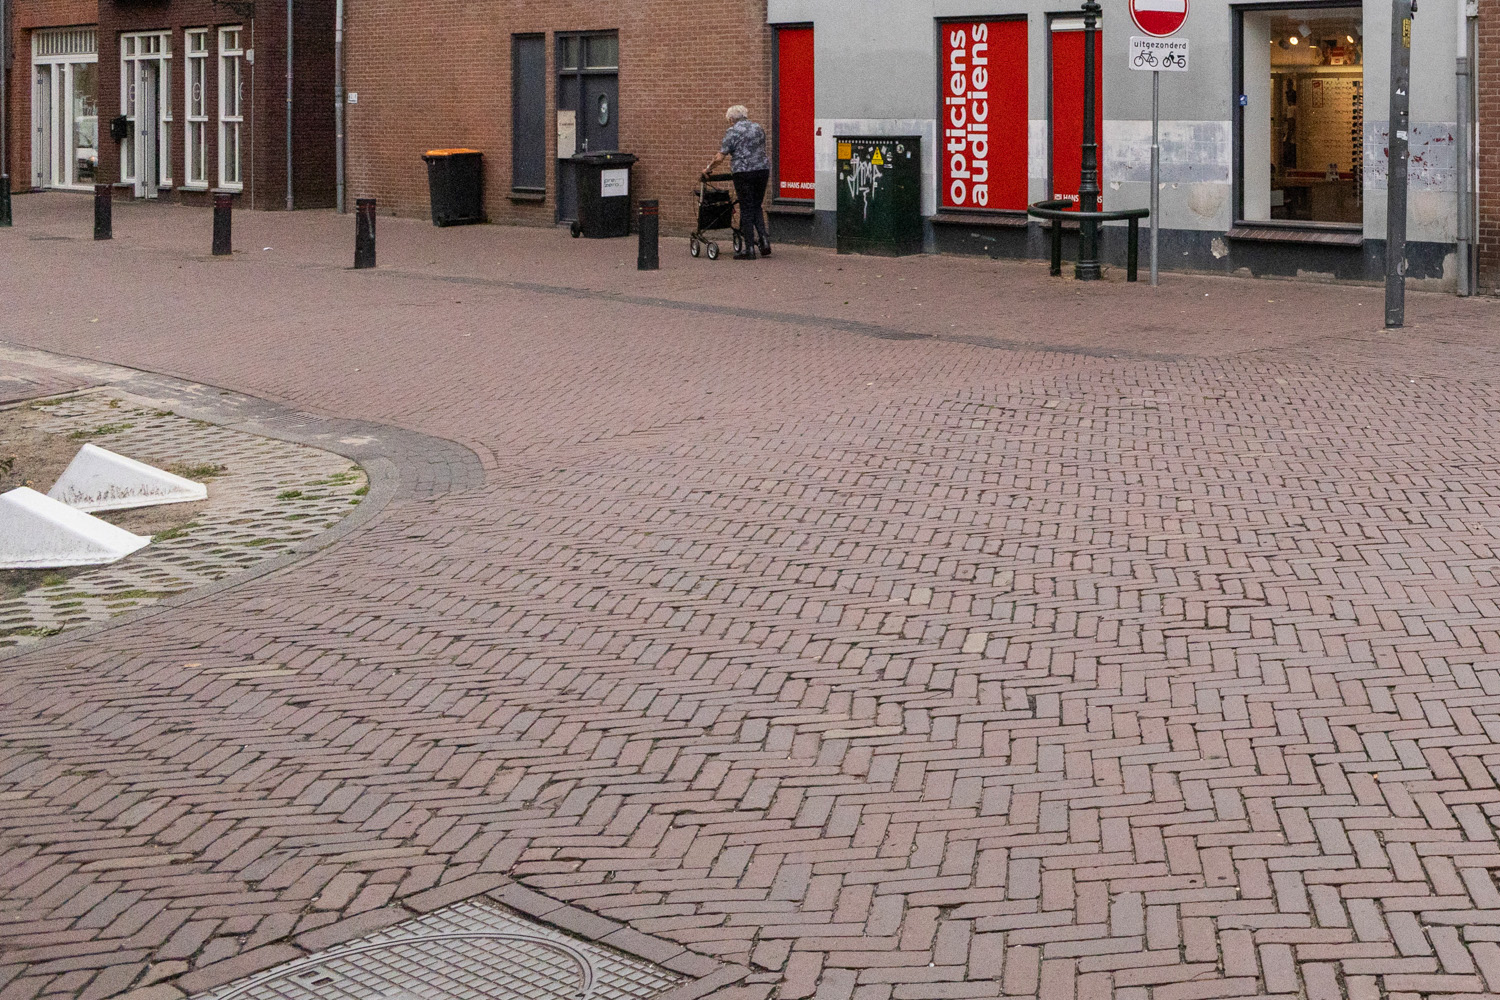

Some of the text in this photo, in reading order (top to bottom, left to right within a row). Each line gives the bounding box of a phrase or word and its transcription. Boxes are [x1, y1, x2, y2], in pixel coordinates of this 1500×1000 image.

[946, 29, 971, 206] opticiens
[967, 23, 989, 207] audiciens
[1134, 41, 1186, 49] uitgezonderd
